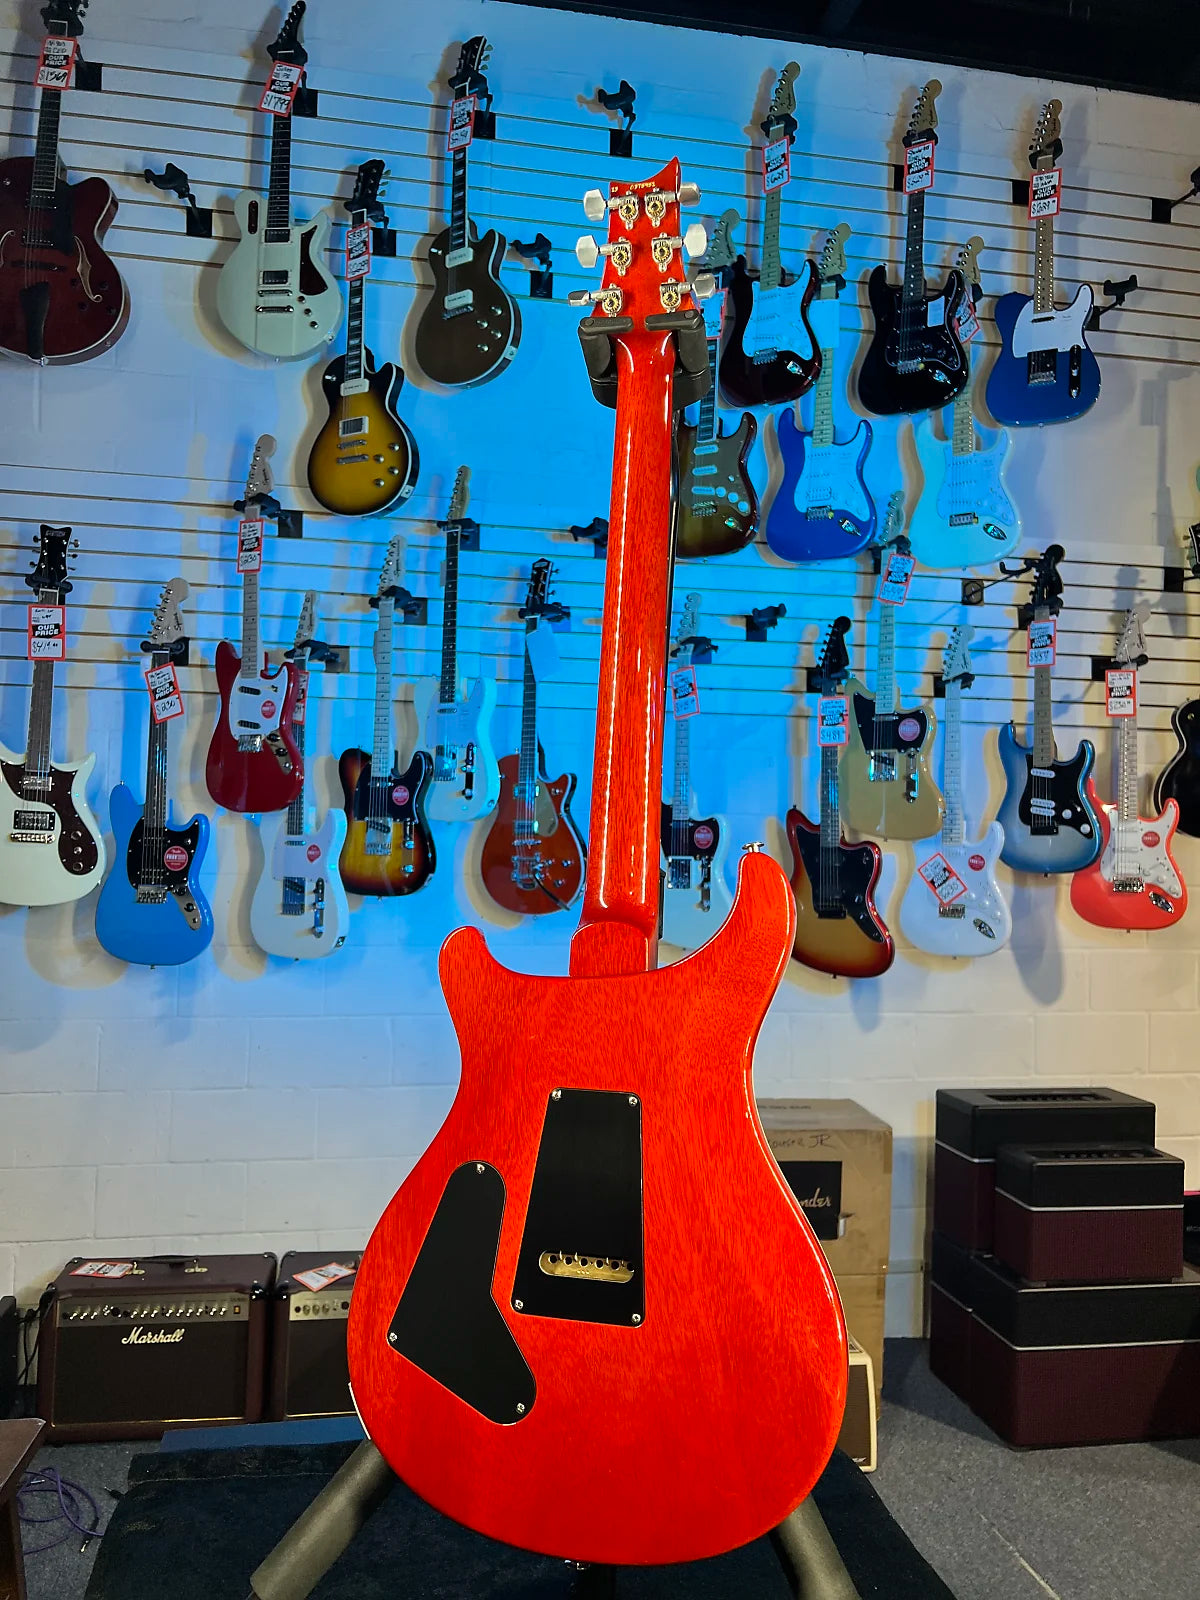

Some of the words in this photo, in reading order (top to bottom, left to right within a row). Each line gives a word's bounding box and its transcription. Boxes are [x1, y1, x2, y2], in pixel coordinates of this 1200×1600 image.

[270, 85, 292, 93] PRICE
[263, 94, 291, 110] $1799
[1034, 189, 1056, 200] PRICE
[34, 628, 60, 637] PRICE
[154, 685, 175, 699] PRICE
[156, 682, 171, 694] OUR
[1110, 690, 1131, 698] PRICE
[799, 1187, 832, 1208] nder
[121, 1326, 185, 1344] Marshall
